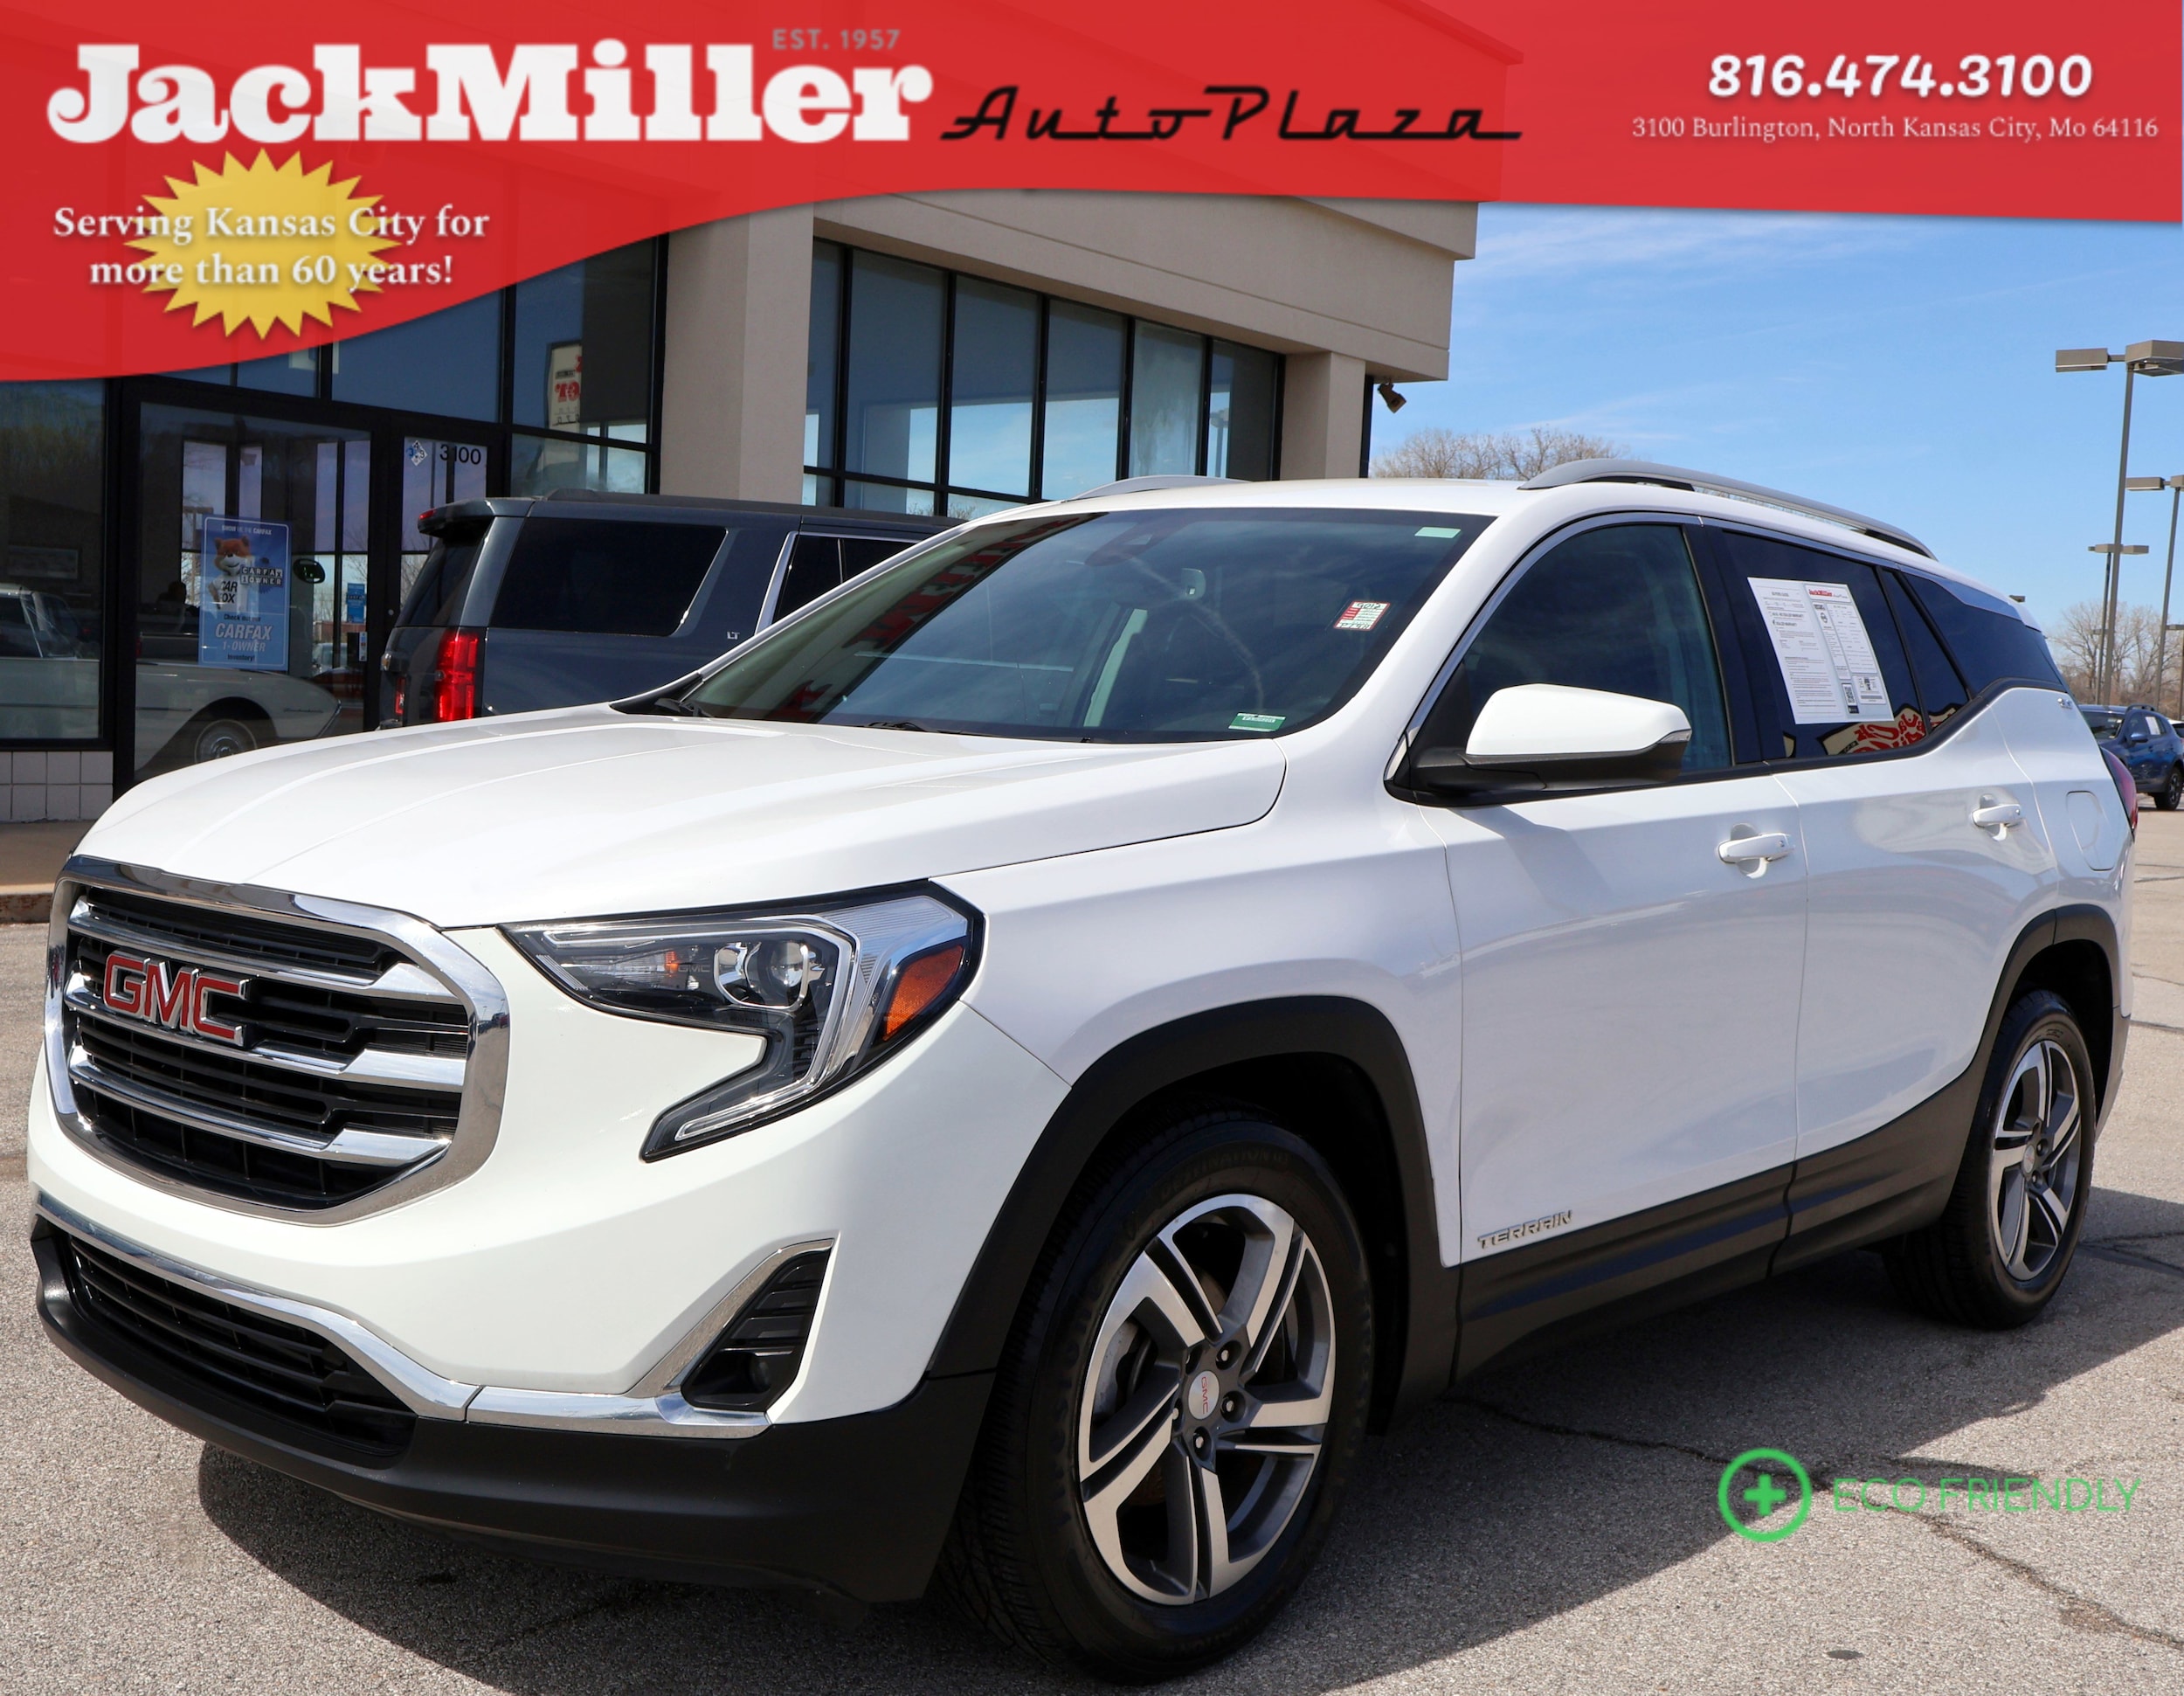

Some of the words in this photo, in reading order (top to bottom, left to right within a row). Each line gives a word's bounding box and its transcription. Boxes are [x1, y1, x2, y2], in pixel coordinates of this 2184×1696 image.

[439, 444, 481, 465] 3100
[242, 566, 283, 578] CARFAX
[215, 622, 273, 640] CARFAX
[726, 631, 741, 640] LT
[677, 964, 711, 973] GMC
[103, 950, 252, 1048] GMC
[1477, 1209, 1572, 1250] TERRAIN
